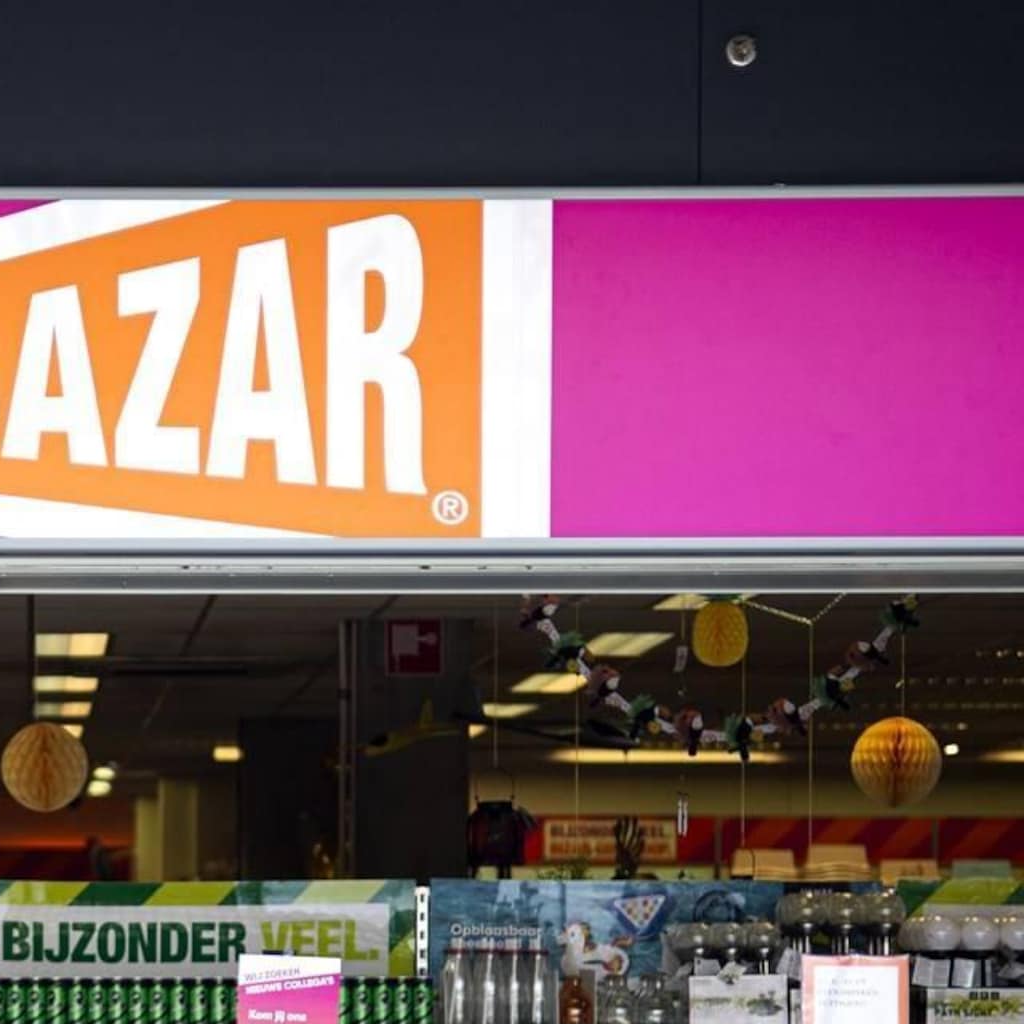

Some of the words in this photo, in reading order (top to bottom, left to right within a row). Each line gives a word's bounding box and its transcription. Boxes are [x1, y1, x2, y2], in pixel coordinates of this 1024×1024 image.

[2, 920, 246, 963] BIJZONDER
[260, 919, 378, 960] VEEL.
[248, 1009, 273, 1021] Kom
[287, 1012, 307, 1021] ons
